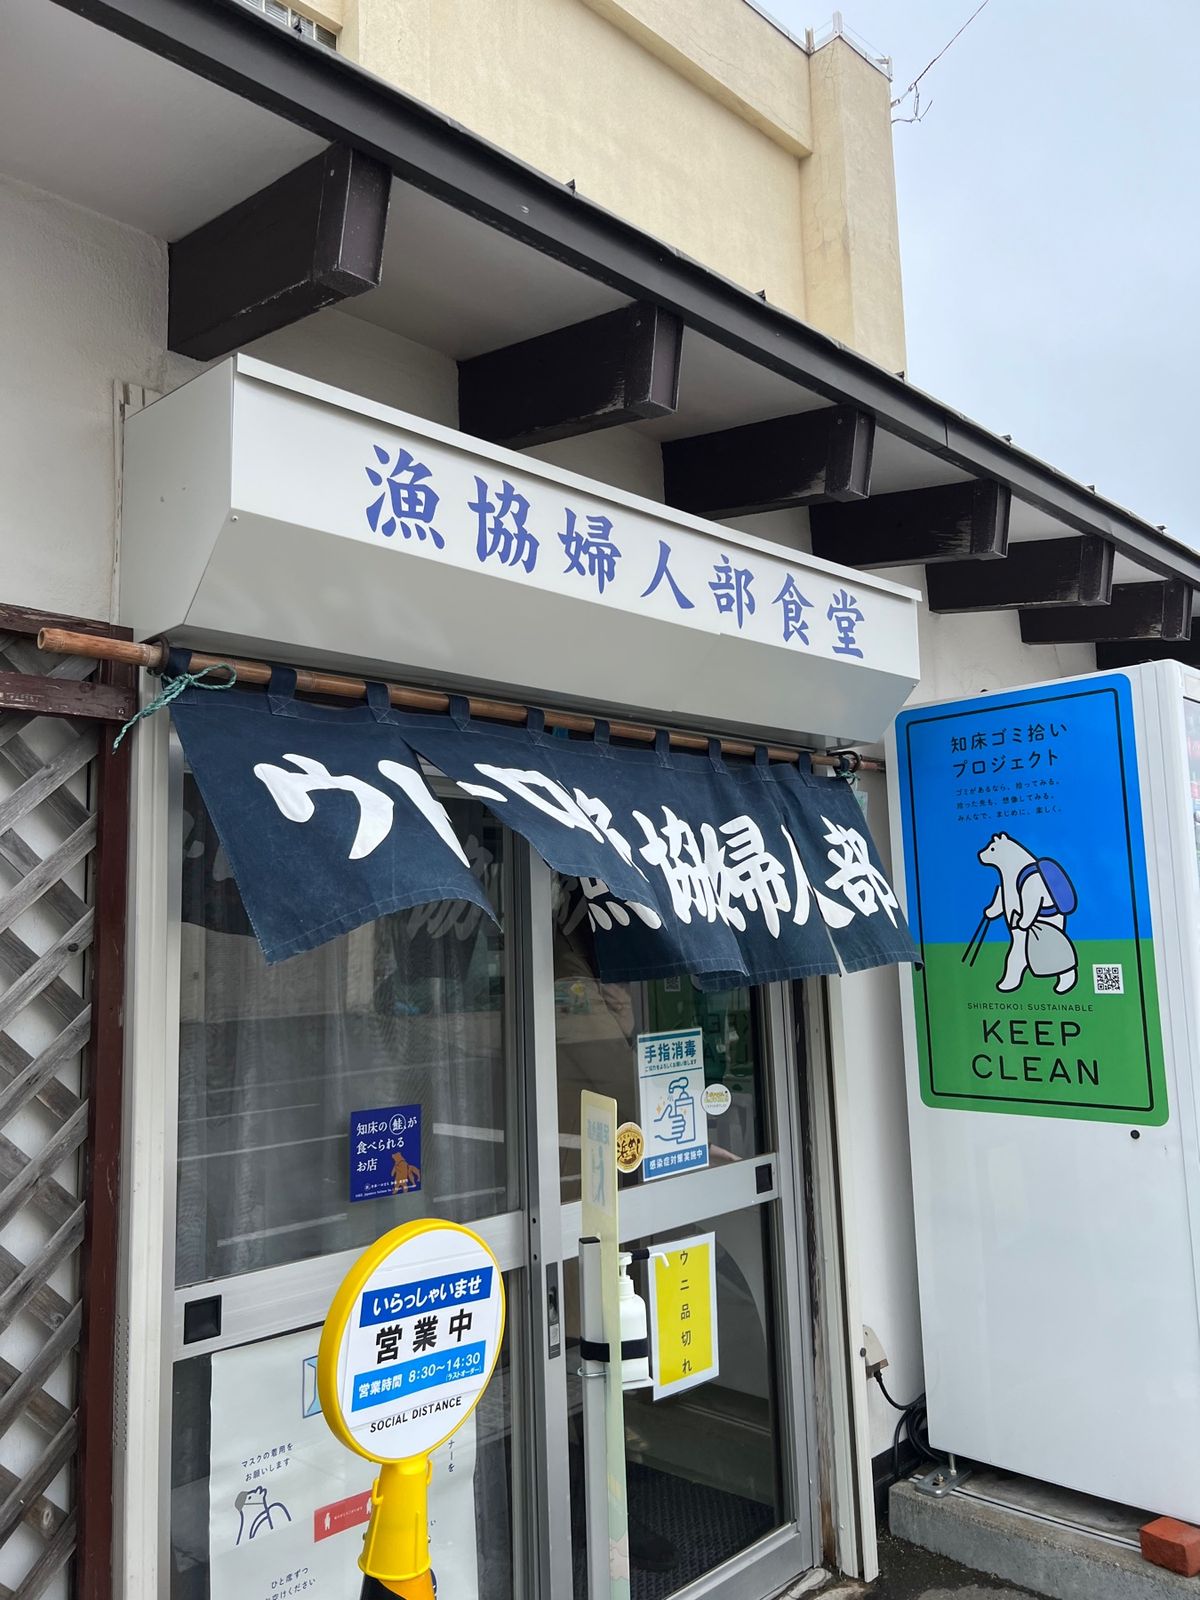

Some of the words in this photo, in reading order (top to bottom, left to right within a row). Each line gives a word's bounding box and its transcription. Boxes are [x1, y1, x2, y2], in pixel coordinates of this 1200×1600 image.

[365, 444, 865, 660] 漁協婦人部食堂
[951, 722, 1067, 754] 知床ゴミ拾い
[952, 749, 1058, 778] プロジェクト
[1027, 1003, 1094, 1012] SUSTAINABLE
[982, 1019, 1081, 1047] KEEP
[644, 1040, 697, 1063] 手指消毒
[972, 1054, 1100, 1085] CLEAN
[356, 1137, 405, 1155] 食べられる
[357, 1158, 378, 1172] お店
[373, 1274, 482, 1316] いらっしゃいませ
[680, 1251, 693, 1375] ウニ品切れ
[375, 1308, 473, 1365] 営業中
[358, 1373, 402, 1399] 営業時間
[370, 1408, 408, 1433] SOCIAL
[412, 1396, 462, 1420] DISTANCE
